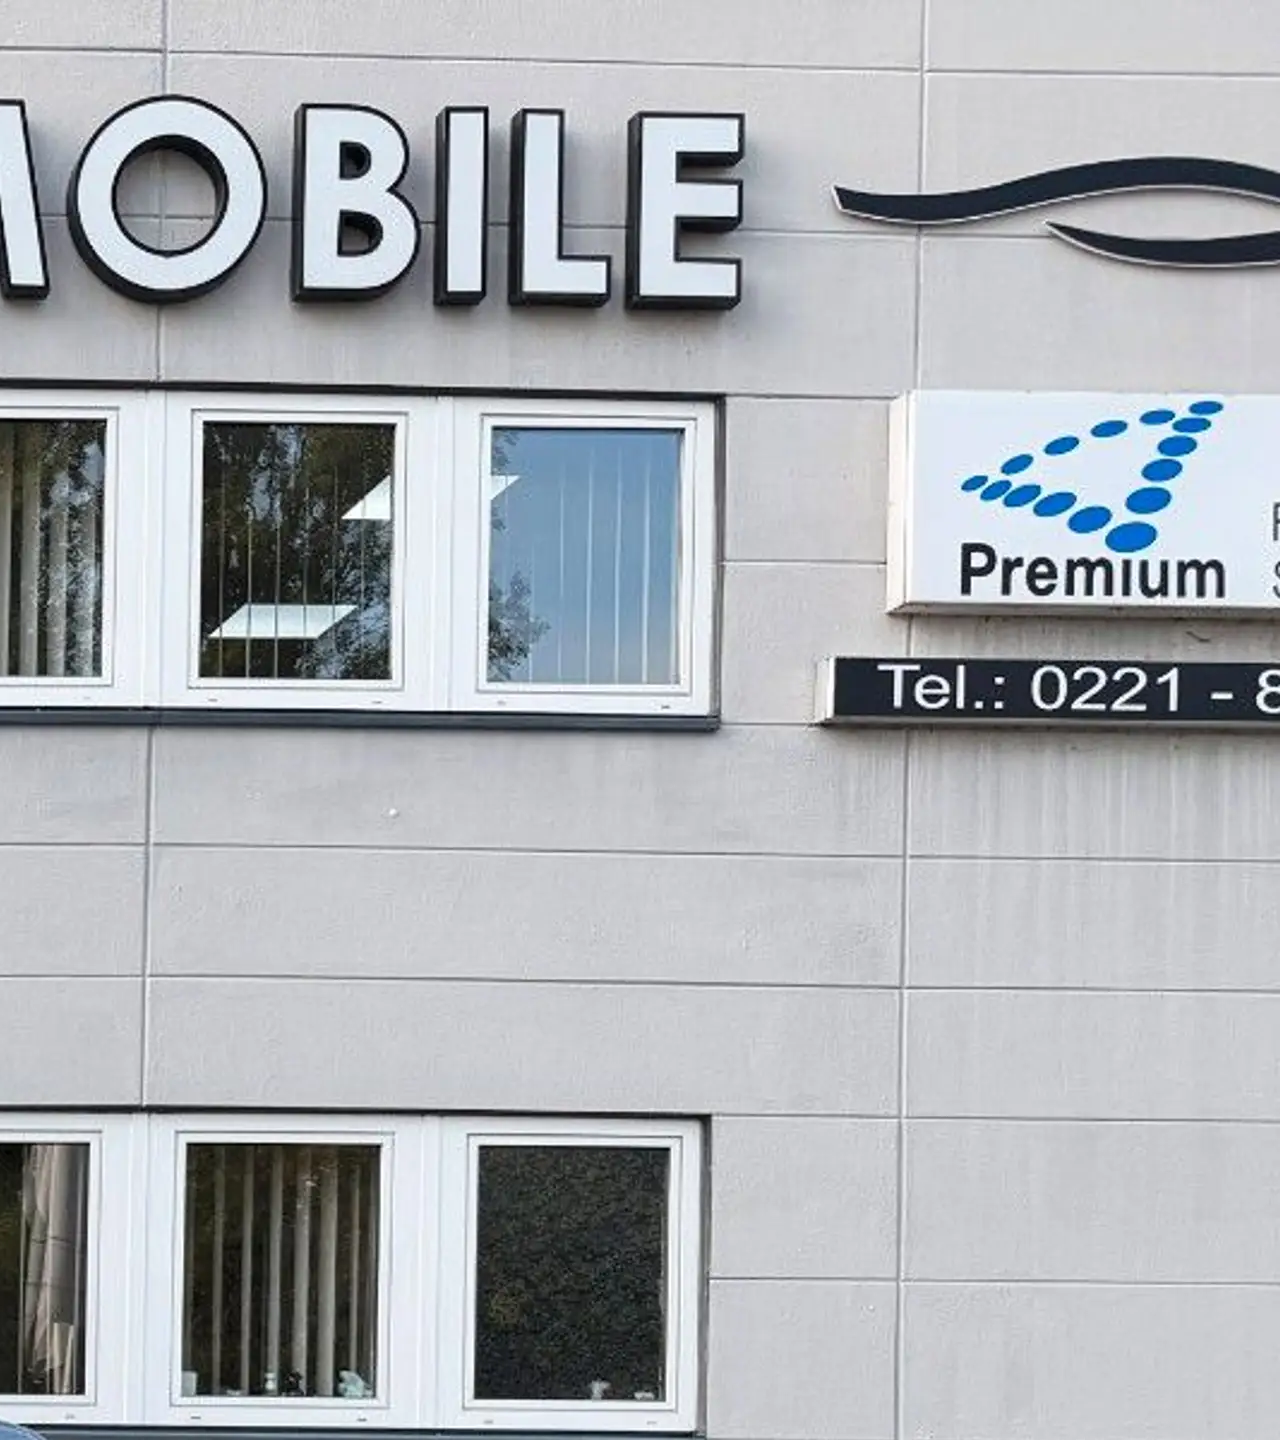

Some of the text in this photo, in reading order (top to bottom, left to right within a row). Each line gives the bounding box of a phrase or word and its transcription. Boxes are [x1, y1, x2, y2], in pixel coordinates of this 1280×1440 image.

[961, 543, 1226, 598] Premium
[878, 664, 1005, 710] Tel.:
[1031, 667, 1179, 712] 0221
